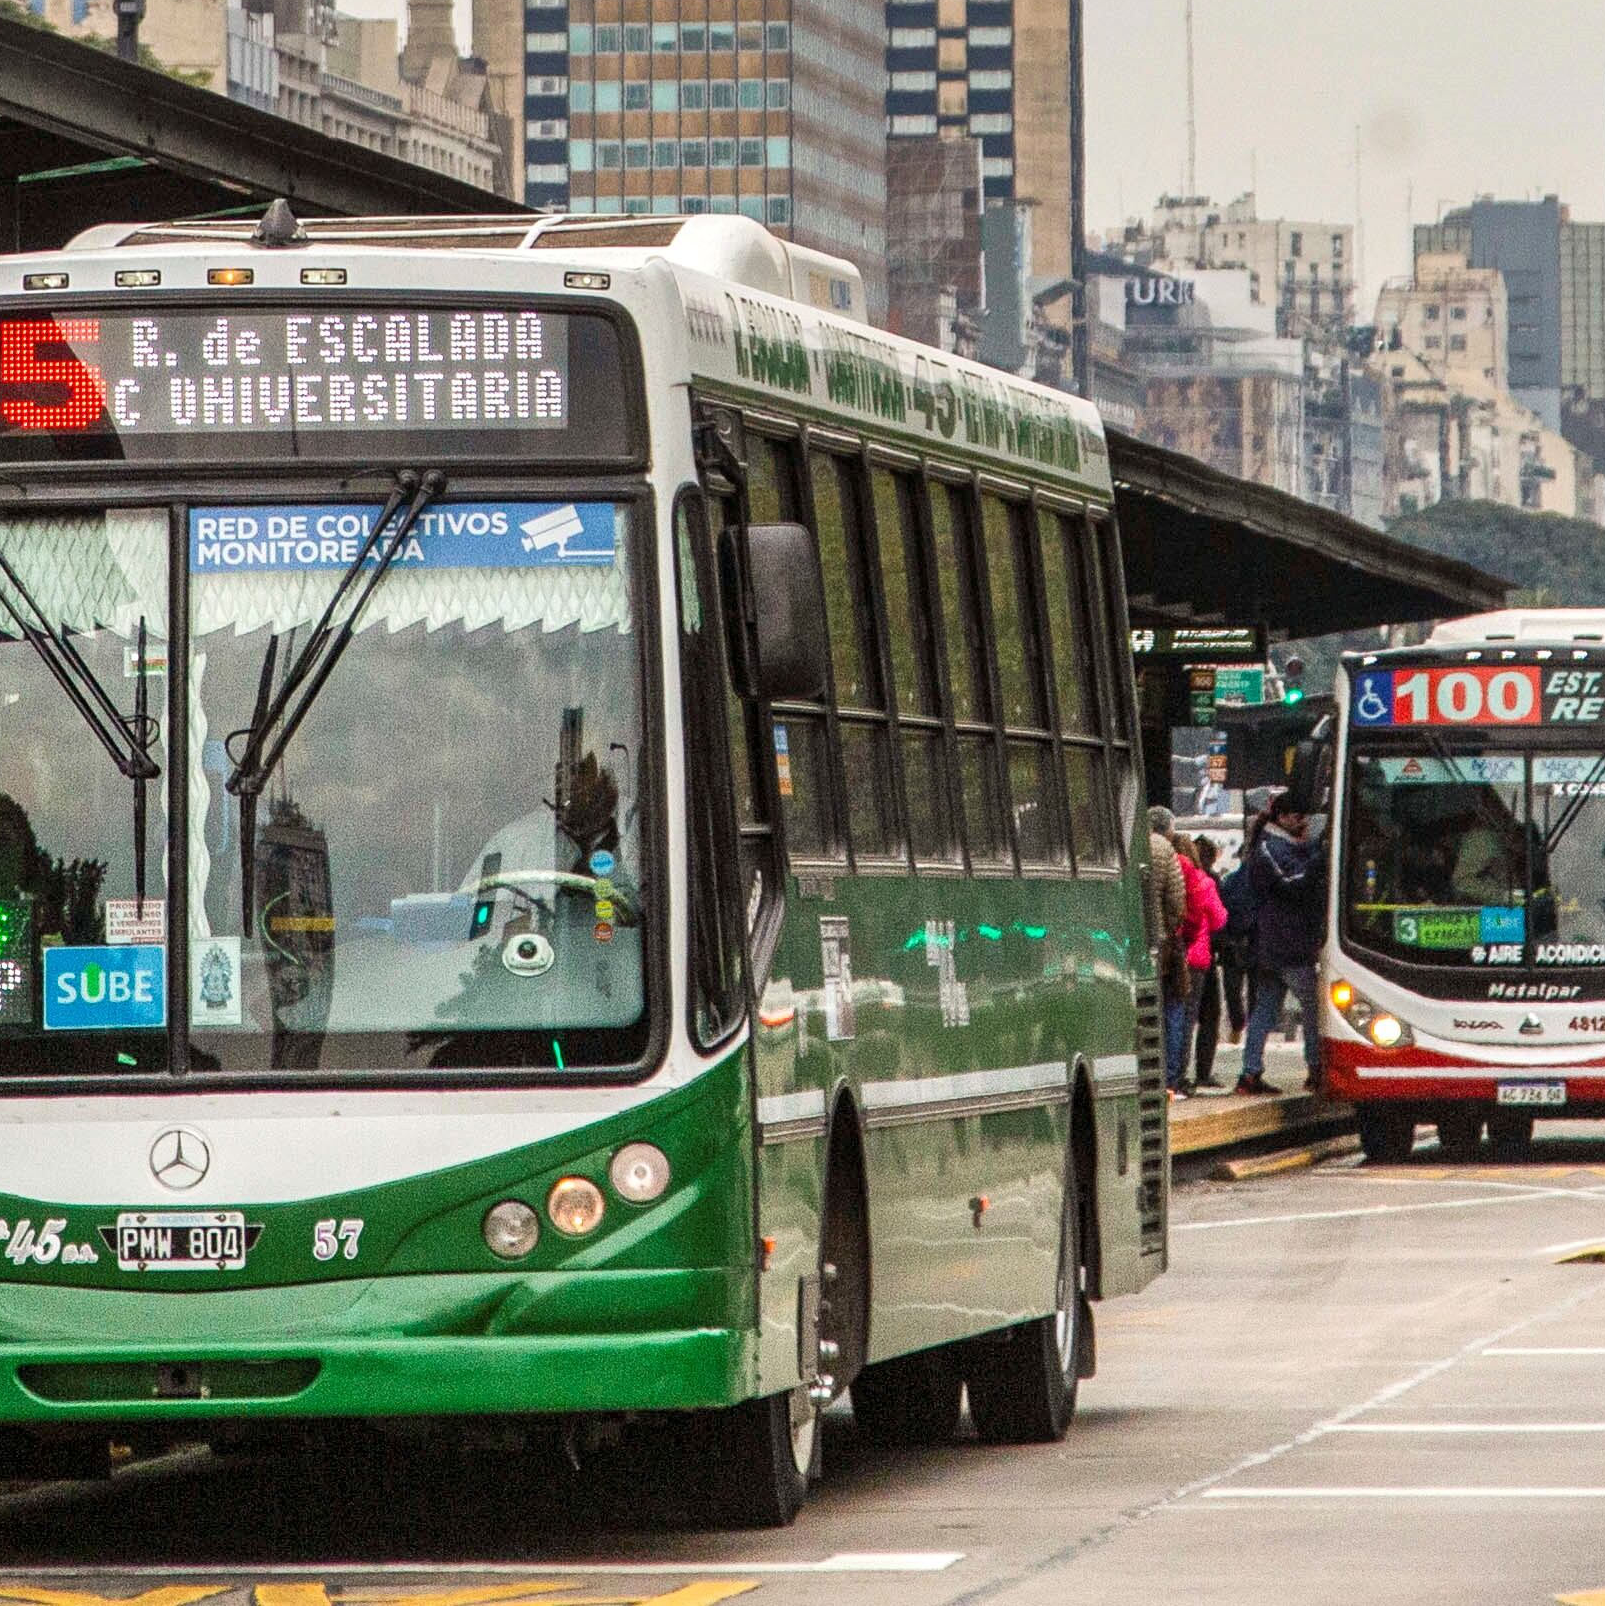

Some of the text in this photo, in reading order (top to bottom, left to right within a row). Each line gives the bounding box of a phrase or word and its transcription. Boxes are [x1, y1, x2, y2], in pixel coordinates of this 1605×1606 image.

[132, 312, 543, 367] R. de ESCALADA
[114, 370, 563, 426] C UNIVERSITARIA
[198, 516, 258, 541] RED
[268, 517, 309, 539] DE
[1396, 671, 1535, 721] 100
[1545, 672, 1596, 694] EST.
[1400, 919, 1417, 941] 3
[1489, 945, 1522, 963] AIRE
[57, 971, 153, 1003] SUBE
[1488, 982, 1581, 998] Metalpar
[5, 1219, 67, 1265] 45
[122, 1227, 240, 1258] PMW 804
[314, 1220, 364, 1260] 57
